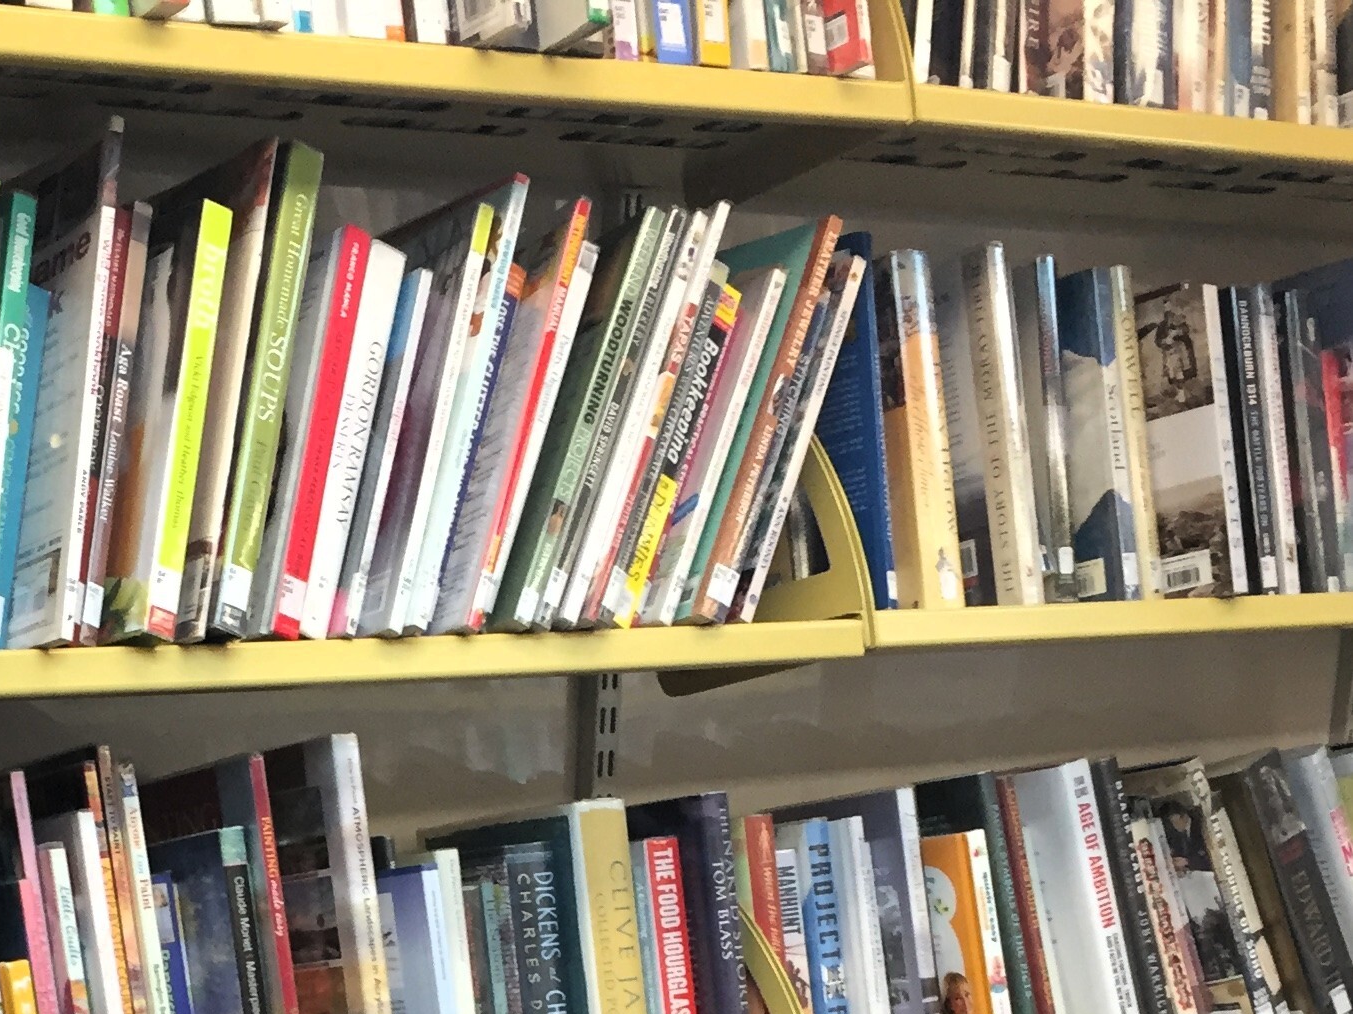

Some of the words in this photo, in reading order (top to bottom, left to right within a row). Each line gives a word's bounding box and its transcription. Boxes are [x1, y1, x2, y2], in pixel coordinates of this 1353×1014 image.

[665, 312, 701, 366] TAPAS
[1237, 299, 1255, 381] BANNOCKBURN
[652, 847, 676, 881] THE
[711, 859, 727, 902] TOM
[776, 864, 802, 936] MANHUNT
[1075, 800, 1097, 833] AGE
[1087, 853, 1116, 930] AMBITION
[513, 872, 544, 986] CHARLES
[607, 858, 637, 961] CLIVE
[656, 882, 681, 929] FOOD
[715, 907, 734, 961] BLASS
[807, 842, 842, 961] PROJECT
